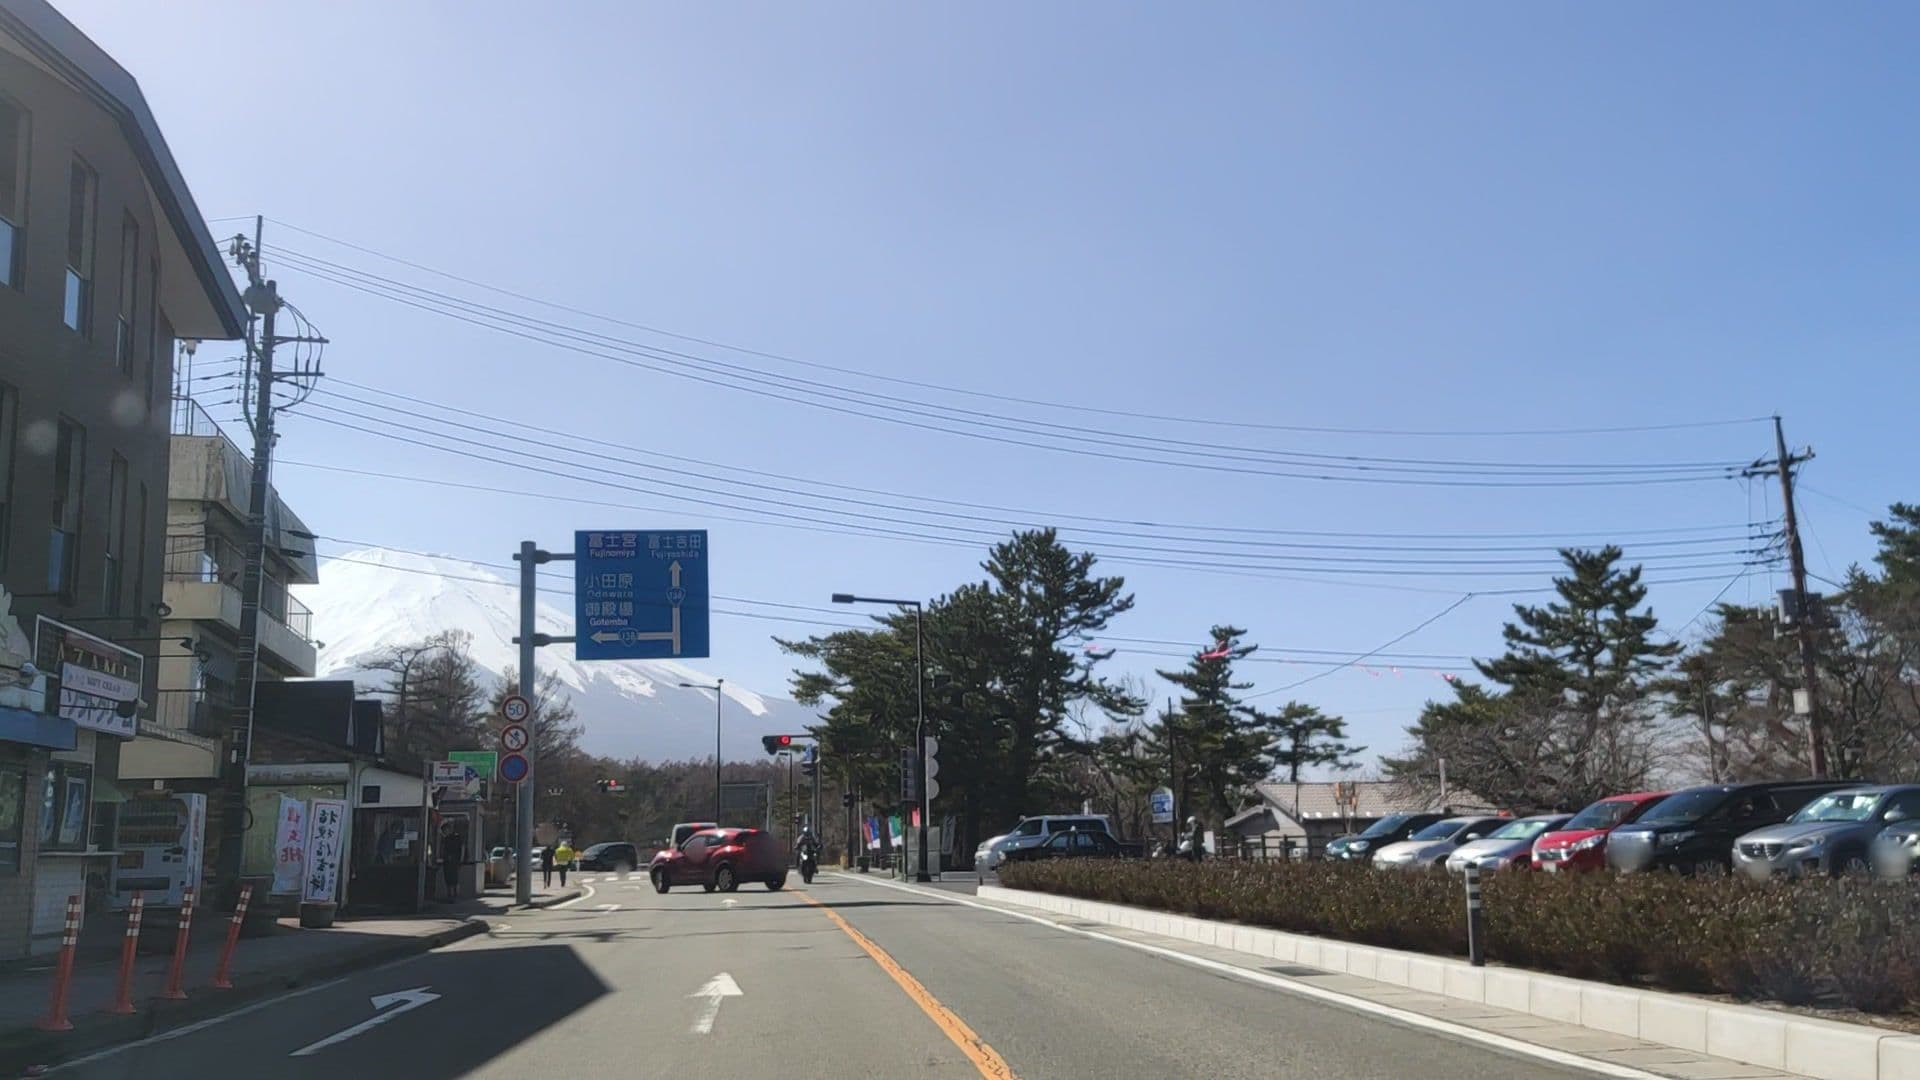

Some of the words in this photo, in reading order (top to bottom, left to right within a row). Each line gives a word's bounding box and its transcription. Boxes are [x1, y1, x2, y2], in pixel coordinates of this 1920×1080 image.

[588, 533, 637, 548] 富士宮
[648, 534, 701, 549] 富士吉田
[590, 549, 635, 559] Fujinomiya
[651, 550, 699, 560] Fujiyoshida
[584, 573, 633, 589] 小田原
[587, 590, 633, 598] Odawara
[585, 601, 633, 616] 御殿場
[589, 617, 628, 627] Gotemba
[56, 642, 127, 678] AZAMI
[65, 690, 134, 729] ソフトクリム
[508, 704, 524, 716] 50
